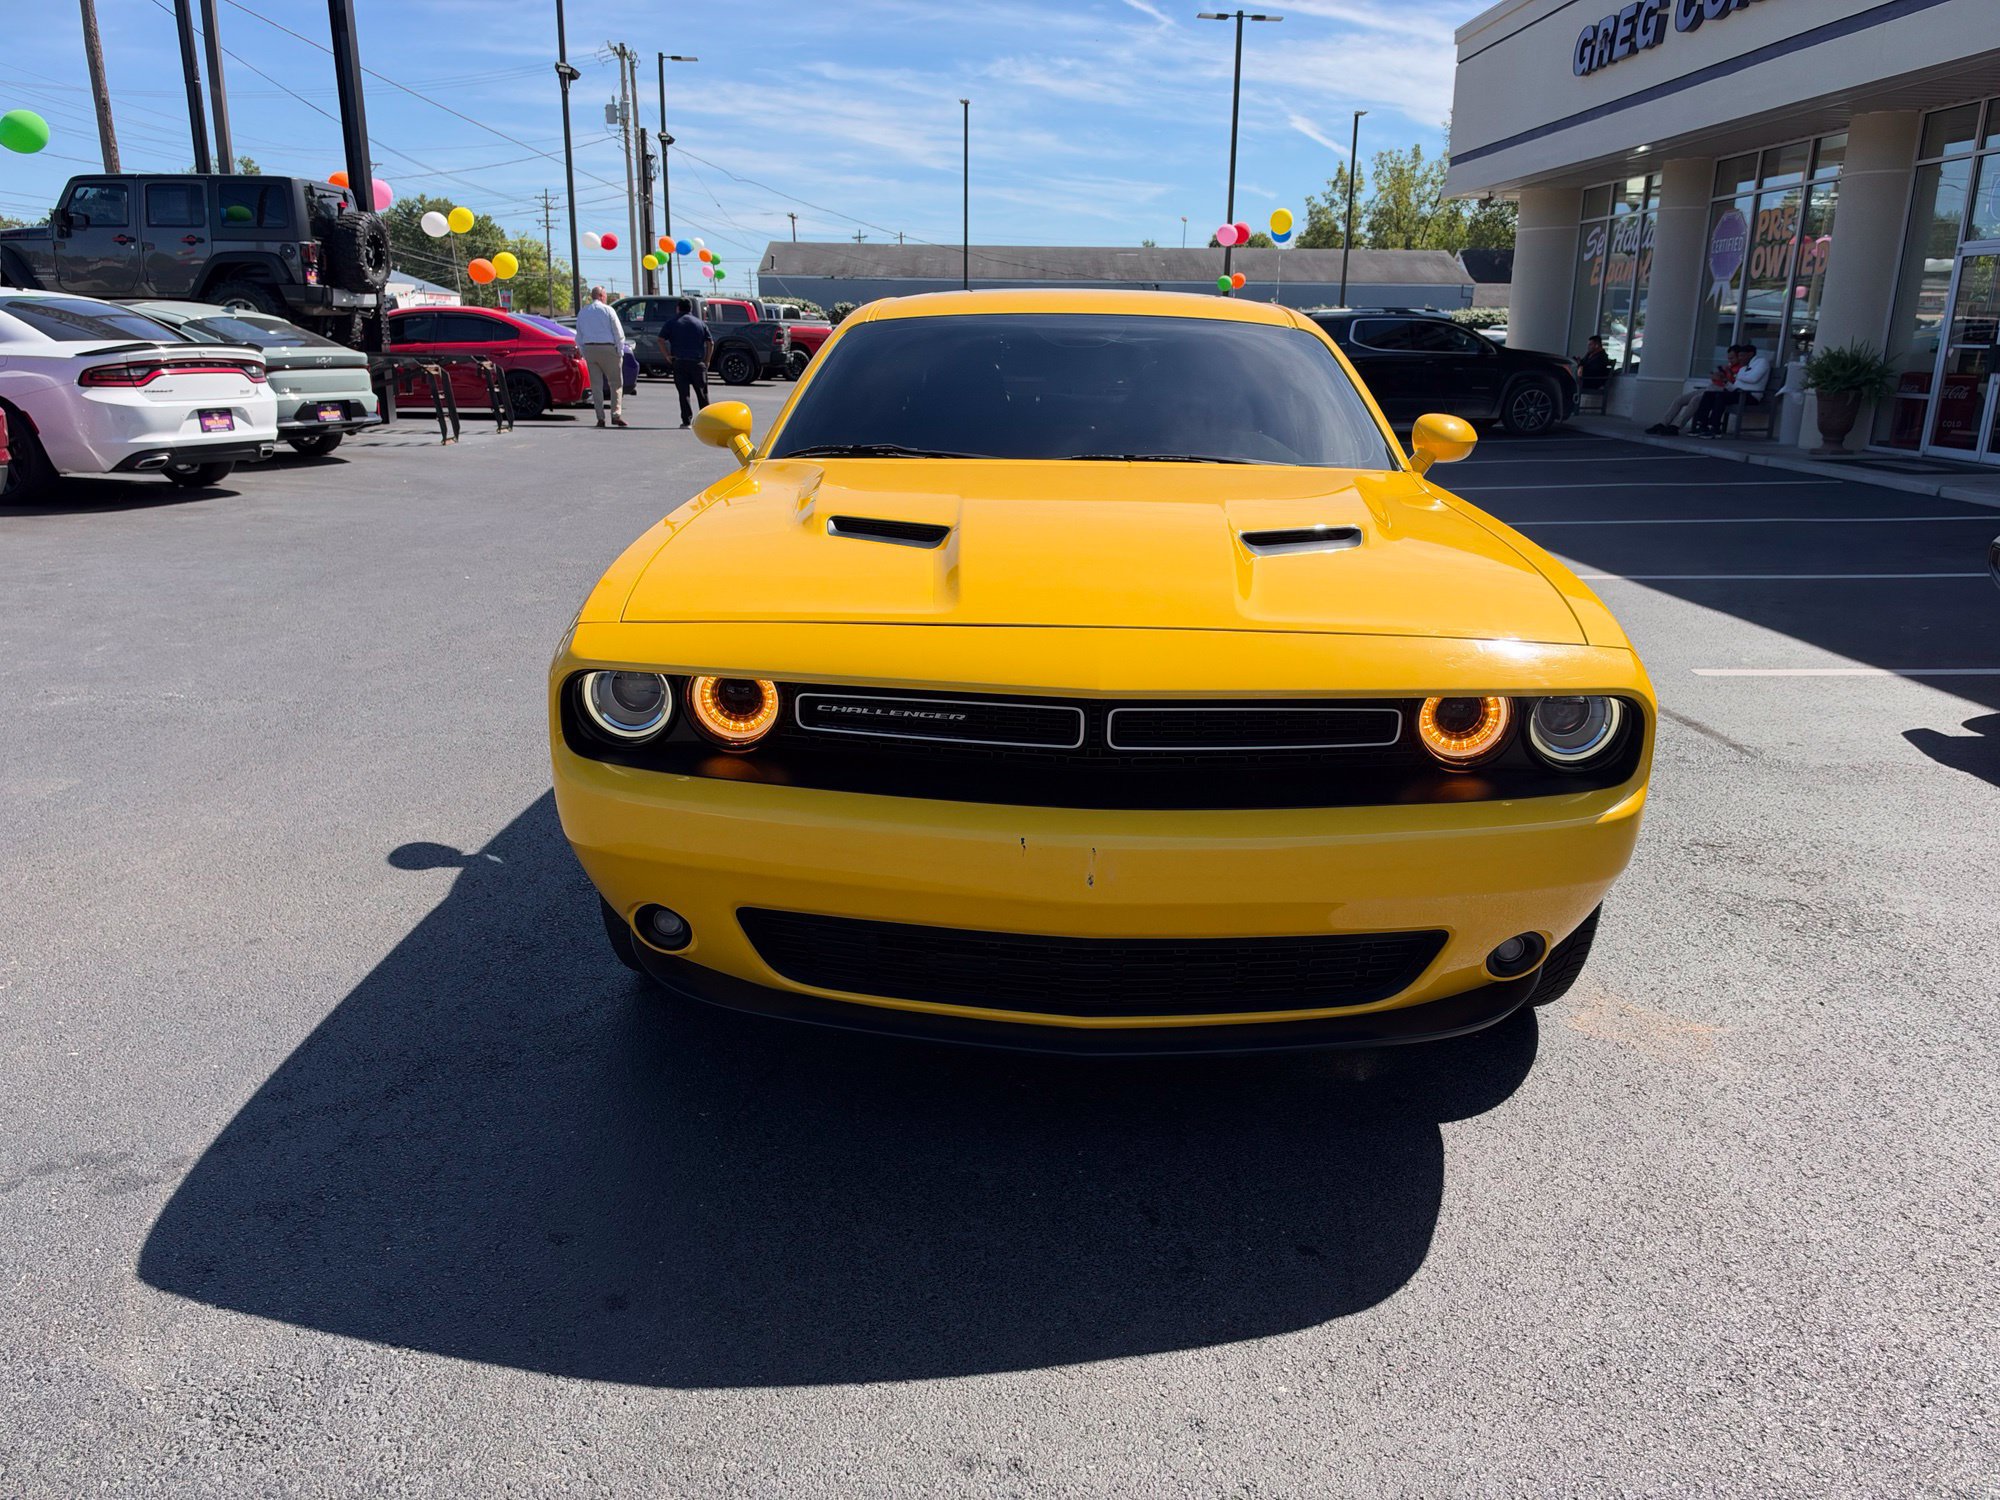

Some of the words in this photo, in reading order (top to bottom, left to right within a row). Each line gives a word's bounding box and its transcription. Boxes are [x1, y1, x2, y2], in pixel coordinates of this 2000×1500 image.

[1573, 0, 1667, 76] GREG
[1584, 225, 1606, 262] Se
[1711, 236, 1743, 254] CERTIFIED
[817, 704, 966, 720] CHALLENGER
